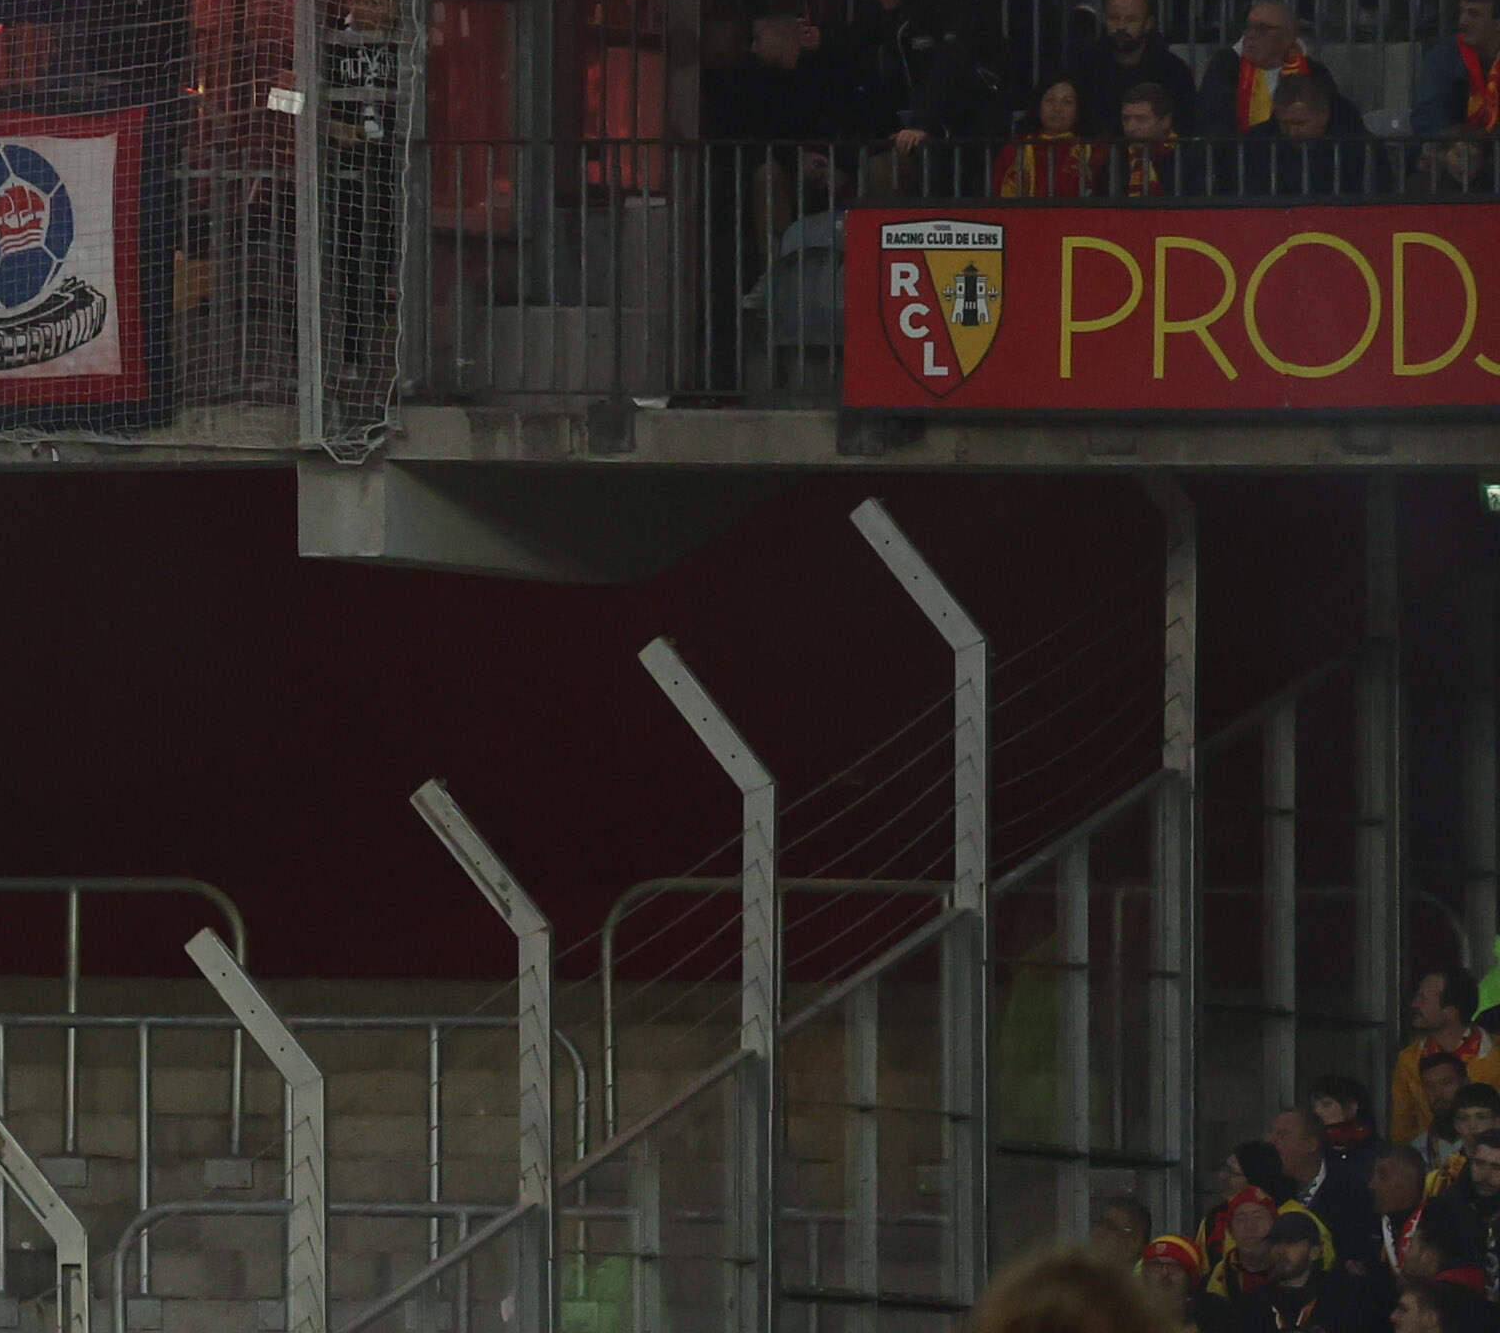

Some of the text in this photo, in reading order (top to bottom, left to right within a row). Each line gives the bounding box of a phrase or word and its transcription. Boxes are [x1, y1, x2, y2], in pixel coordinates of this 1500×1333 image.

[885, 232, 998, 246] RACING CLUB DE LENS
[1060, 232, 1500, 380] PROD
